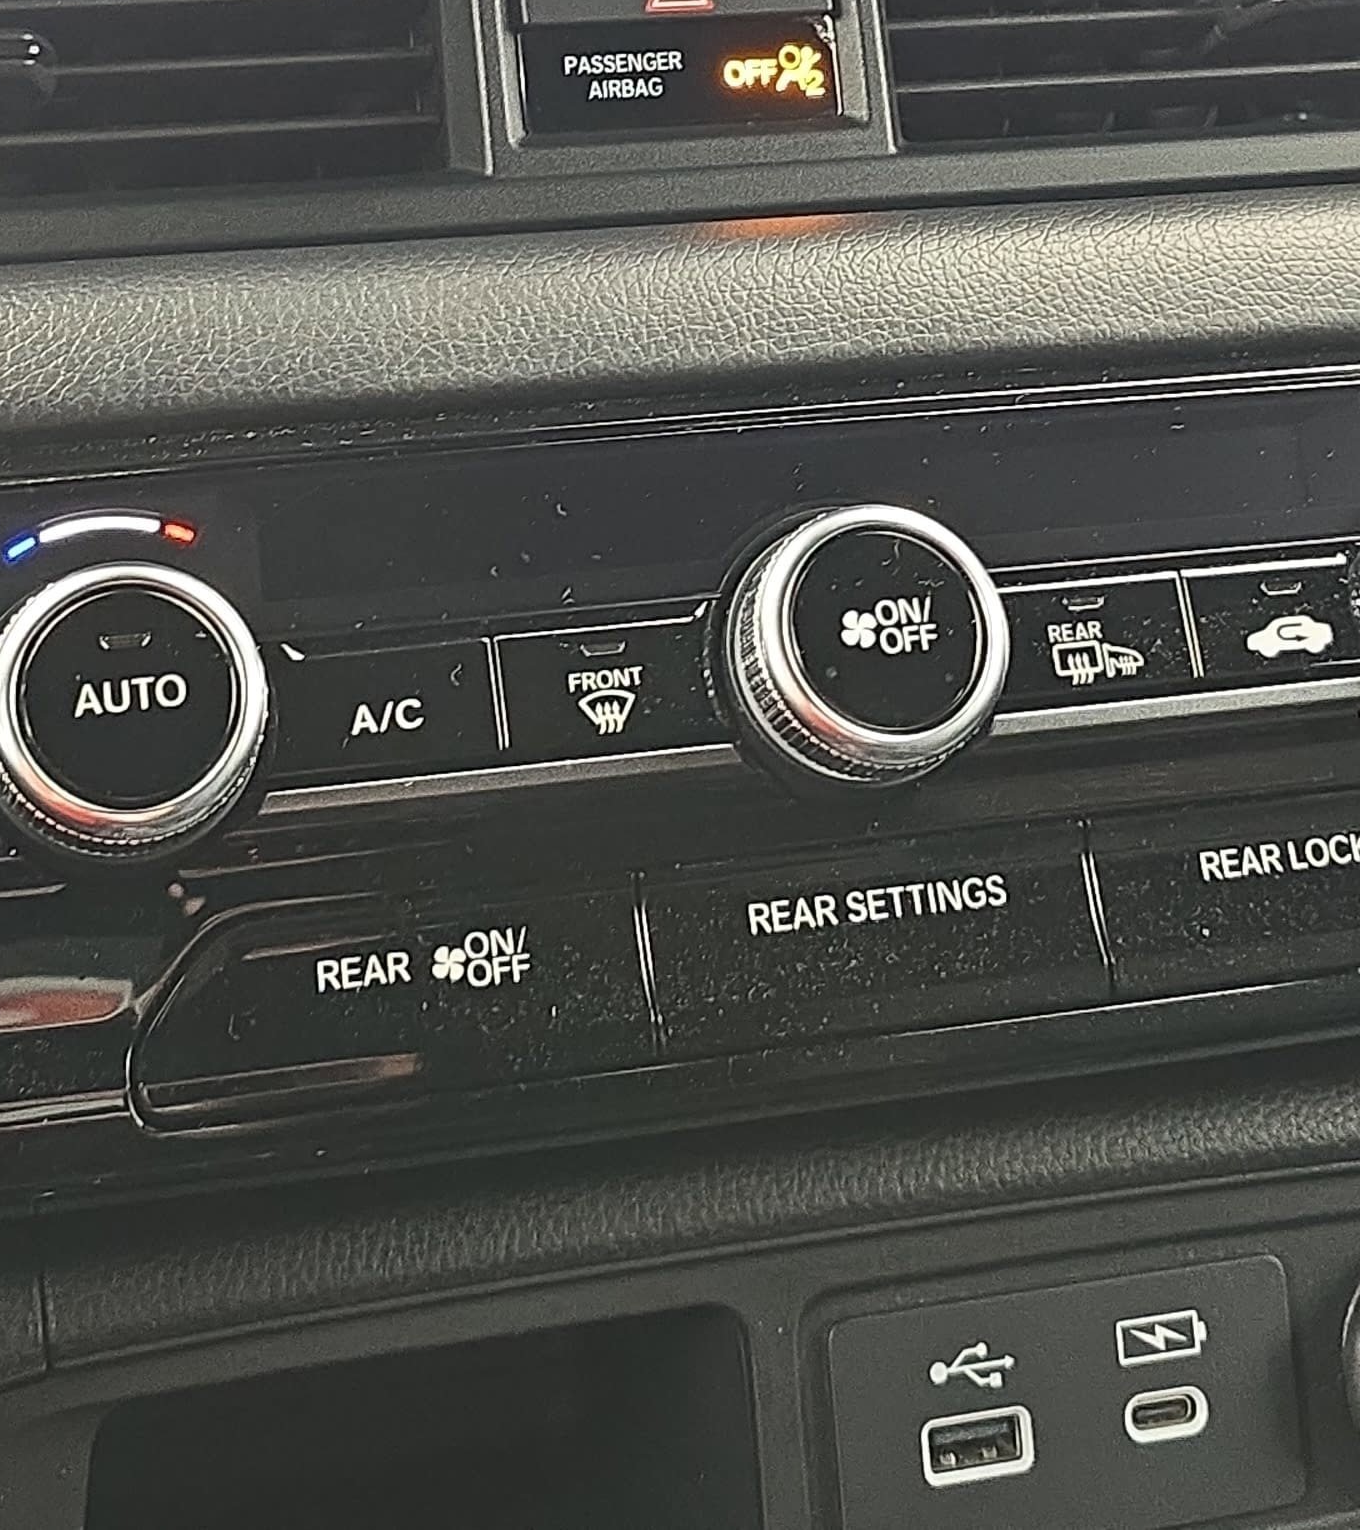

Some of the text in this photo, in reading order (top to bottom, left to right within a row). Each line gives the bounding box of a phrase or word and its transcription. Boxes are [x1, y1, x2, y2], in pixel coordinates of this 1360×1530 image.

[563, 51, 683, 77] PASSENGER
[723, 59, 778, 88] OFF
[588, 76, 664, 101] AIRBAG
[874, 595, 932, 628] ON/
[878, 624, 938, 655] OFF
[1048, 621, 1104, 643] REAR
[74, 673, 187, 718] AUTO
[567, 666, 643, 694] FRONT
[350, 698, 425, 736] A/C
[1200, 843, 1283, 881] REAR
[748, 875, 1008, 936] REAR SETTINGS
[316, 926, 528, 993] REAR ON/
[468, 953, 531, 988] OFF
